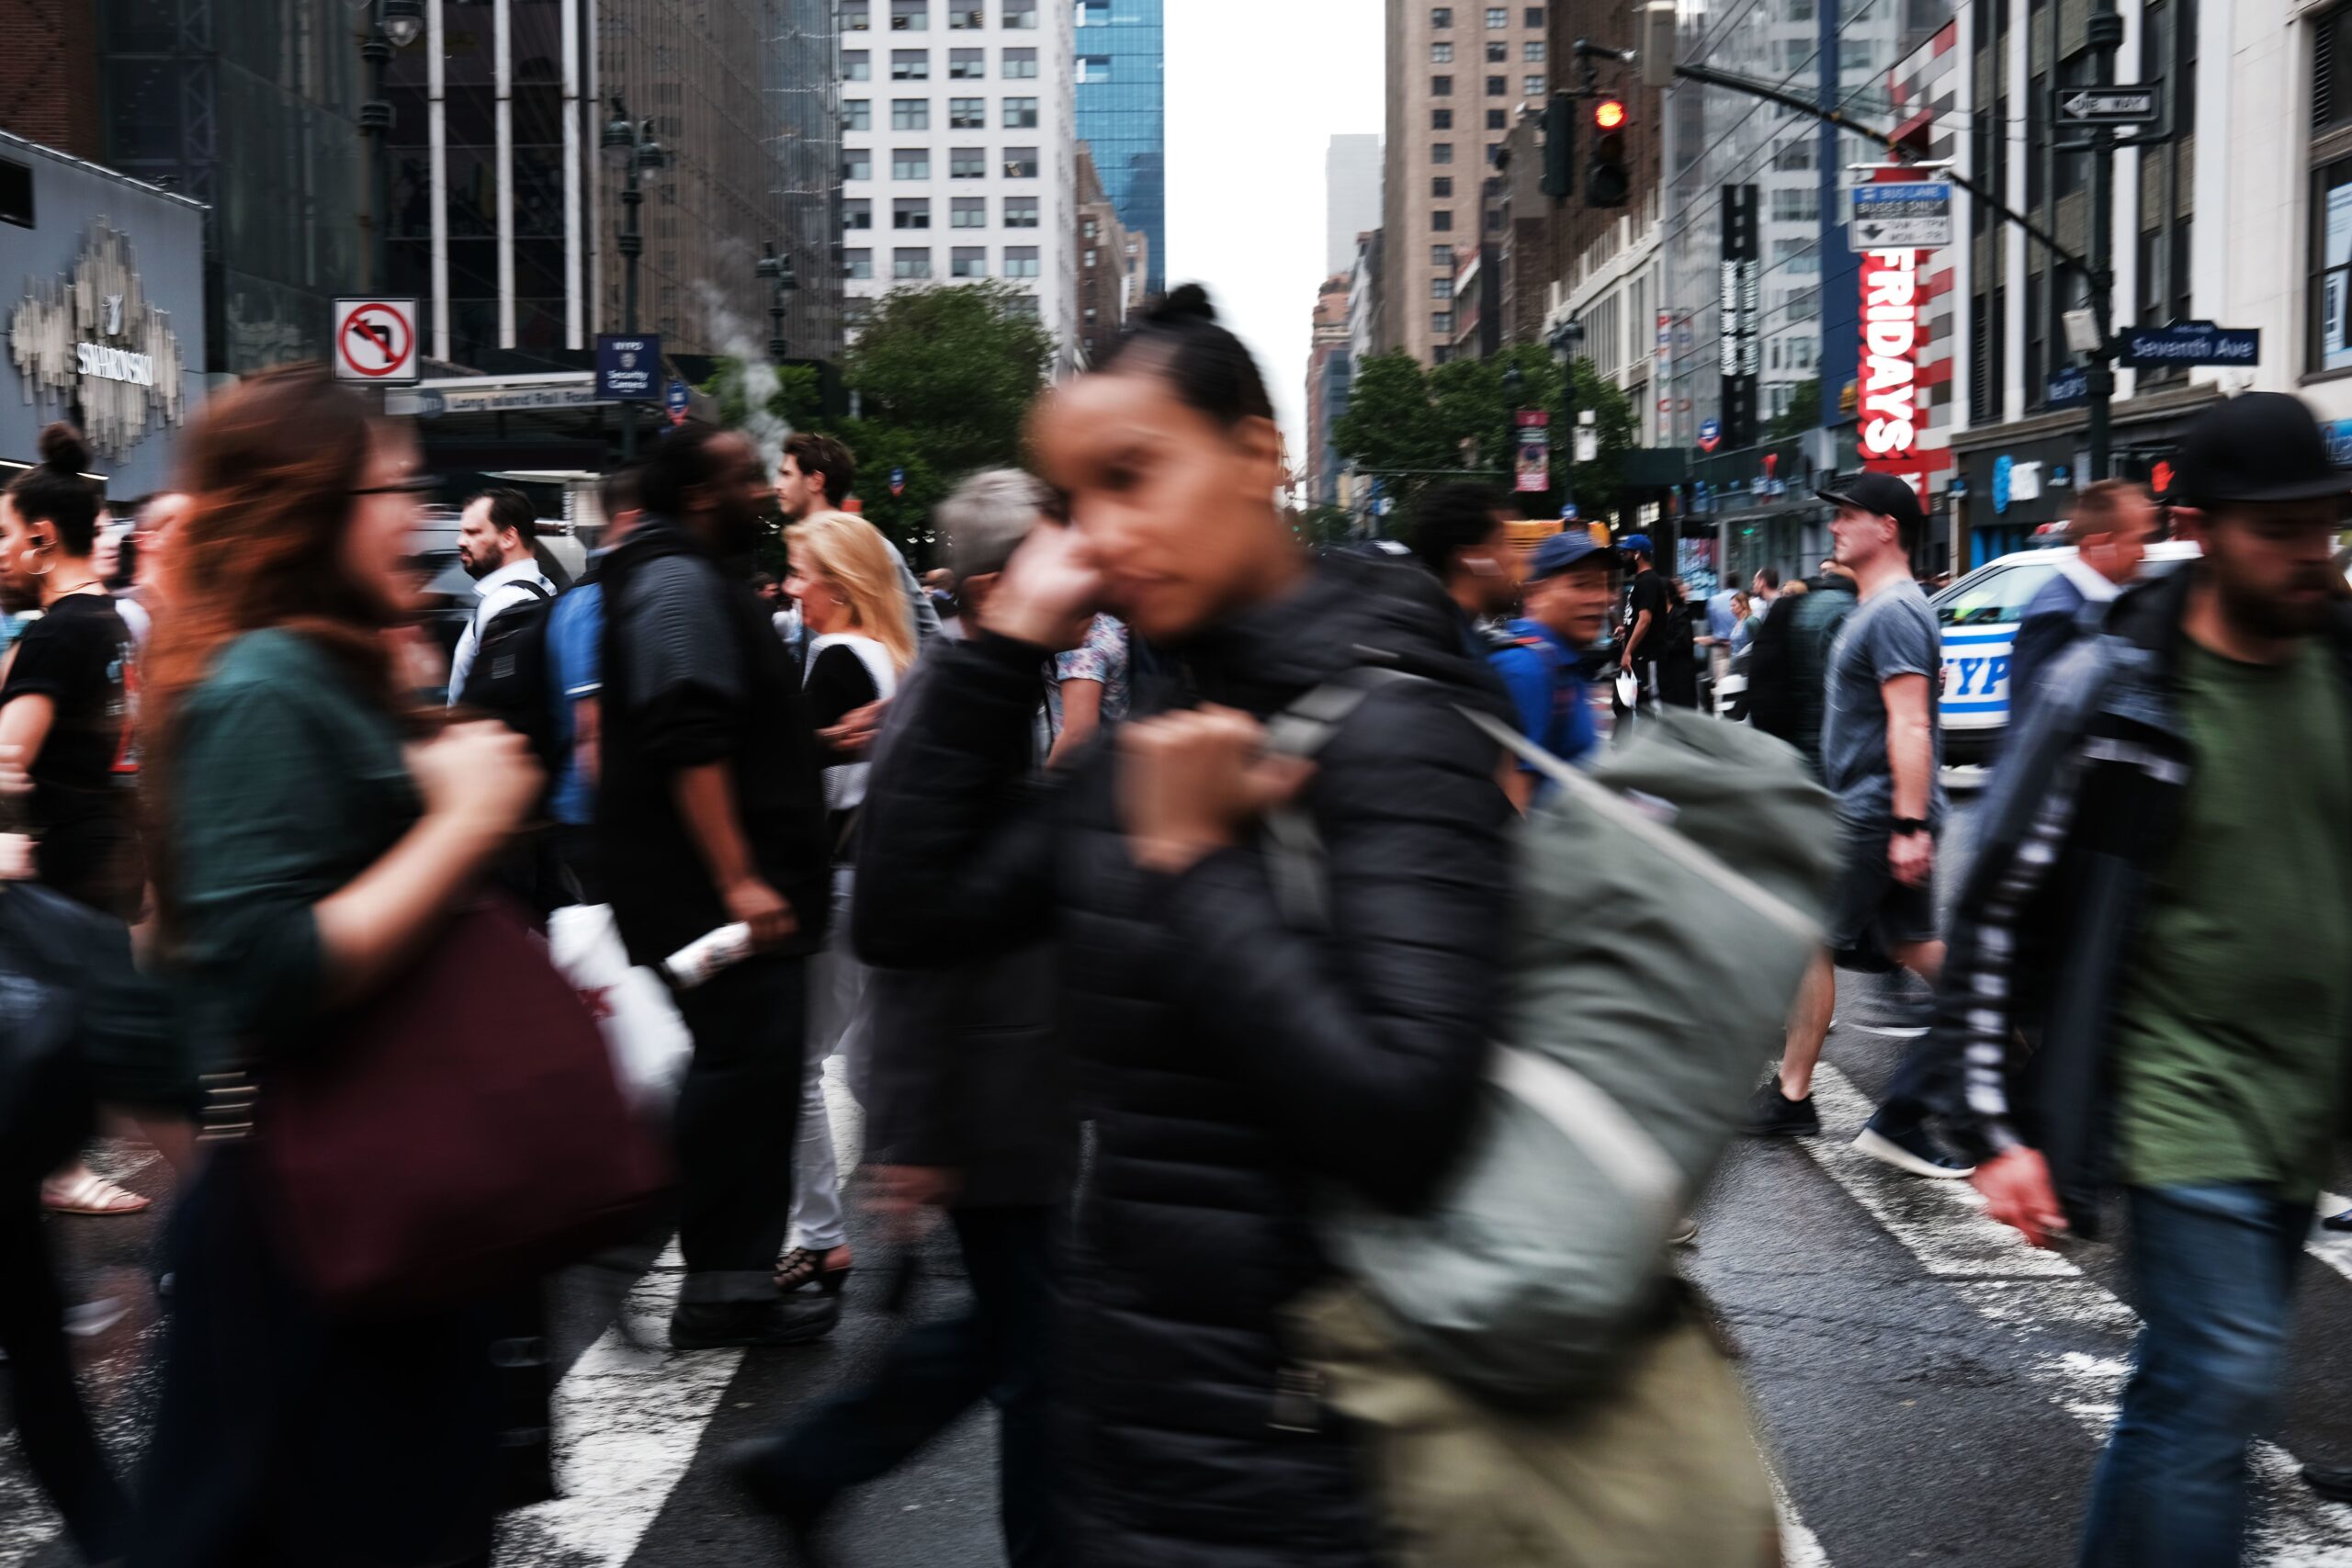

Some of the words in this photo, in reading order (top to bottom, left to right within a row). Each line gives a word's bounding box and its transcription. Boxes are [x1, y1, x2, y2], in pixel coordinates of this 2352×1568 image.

[1865, 248, 1915, 453] FRIDAYS
[2132, 337, 2211, 357] Seventh
[2213, 337, 2255, 357] Ave
[606, 369, 650, 381] Security
[565, 389, 597, 402] Roa
